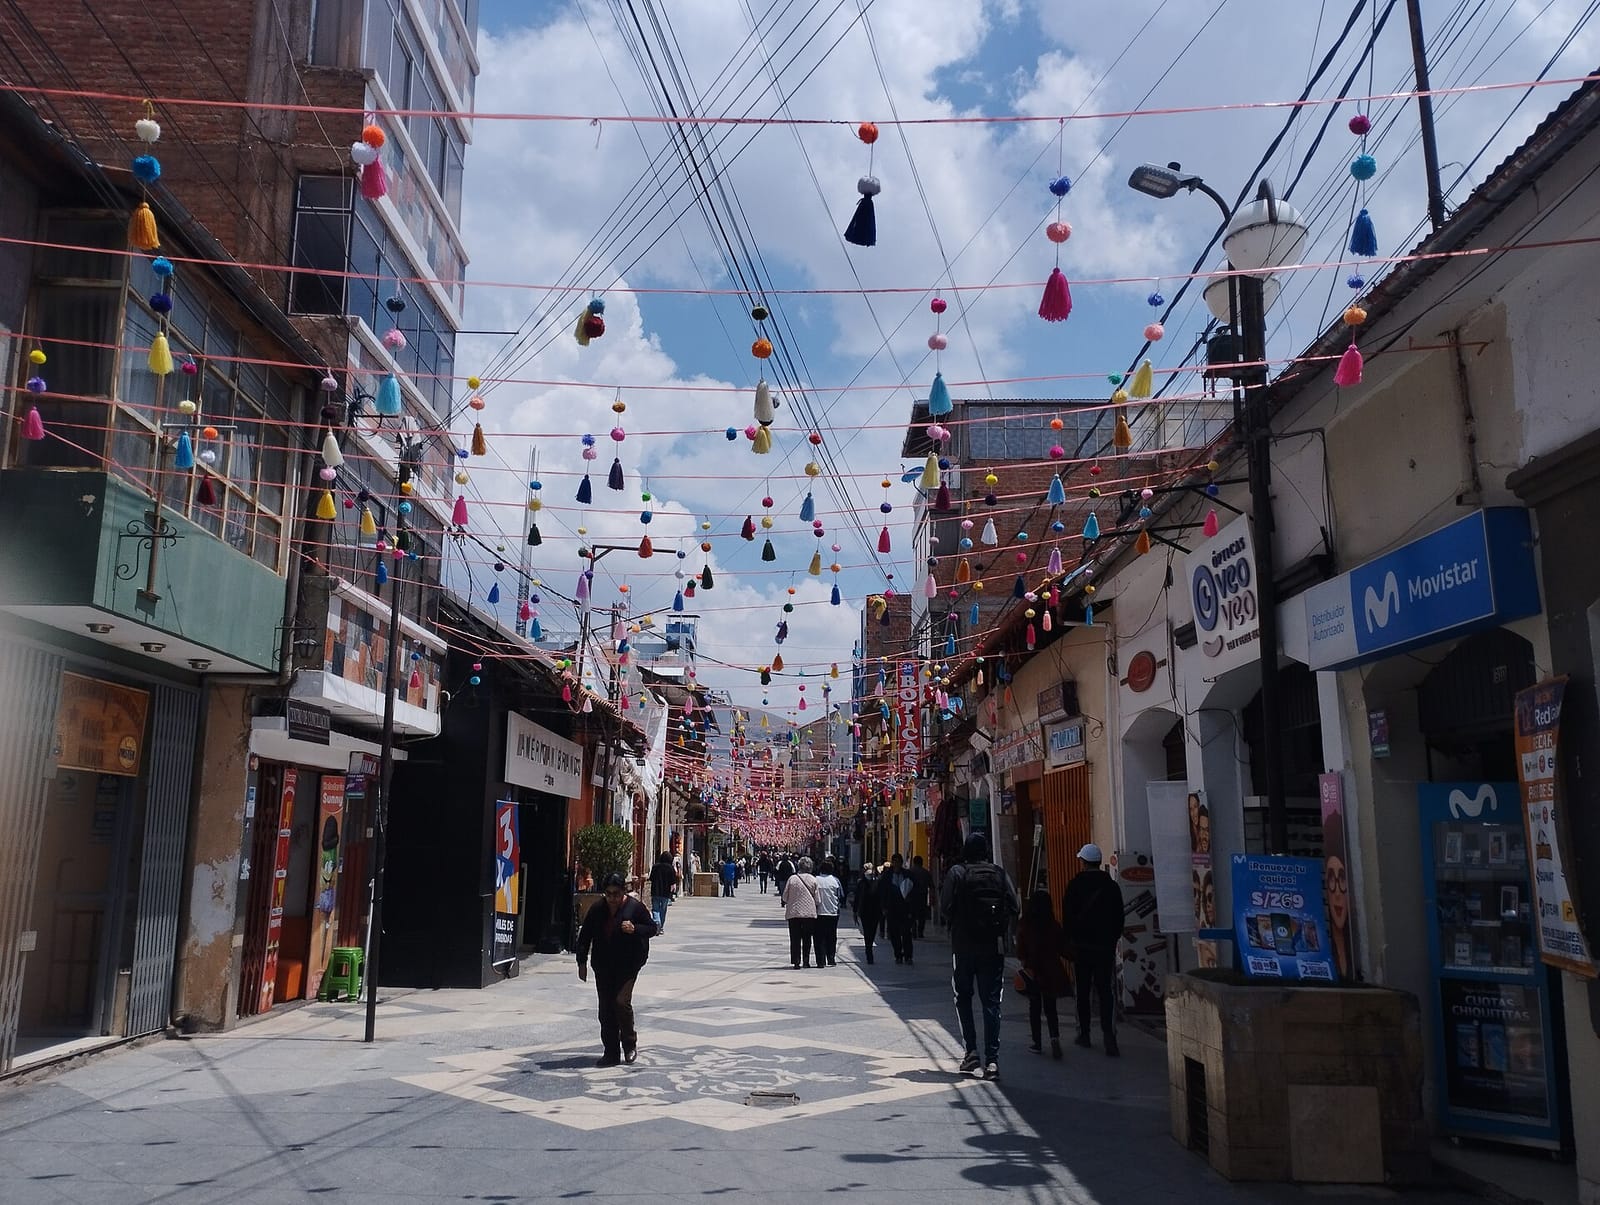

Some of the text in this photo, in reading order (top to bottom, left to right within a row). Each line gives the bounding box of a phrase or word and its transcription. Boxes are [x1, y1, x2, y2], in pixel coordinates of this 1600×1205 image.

[1408, 557, 1479, 603] Movistar
[1311, 604, 1346, 627] Distribuidor
[1312, 620, 1345, 641] Autorizado
[900, 675, 918, 767] BOTICAS
[1534, 705, 1551, 726] Red
[322, 792, 344, 807] Sunny
[1248, 861, 1307, 873] ¡Renueva tu
[1259, 874, 1297, 885] equipo!
[1251, 891, 1305, 909] S/269
[1464, 994, 1514, 1007] CUOTAS
[1451, 1004, 1530, 1020] CHIQUITITAS
